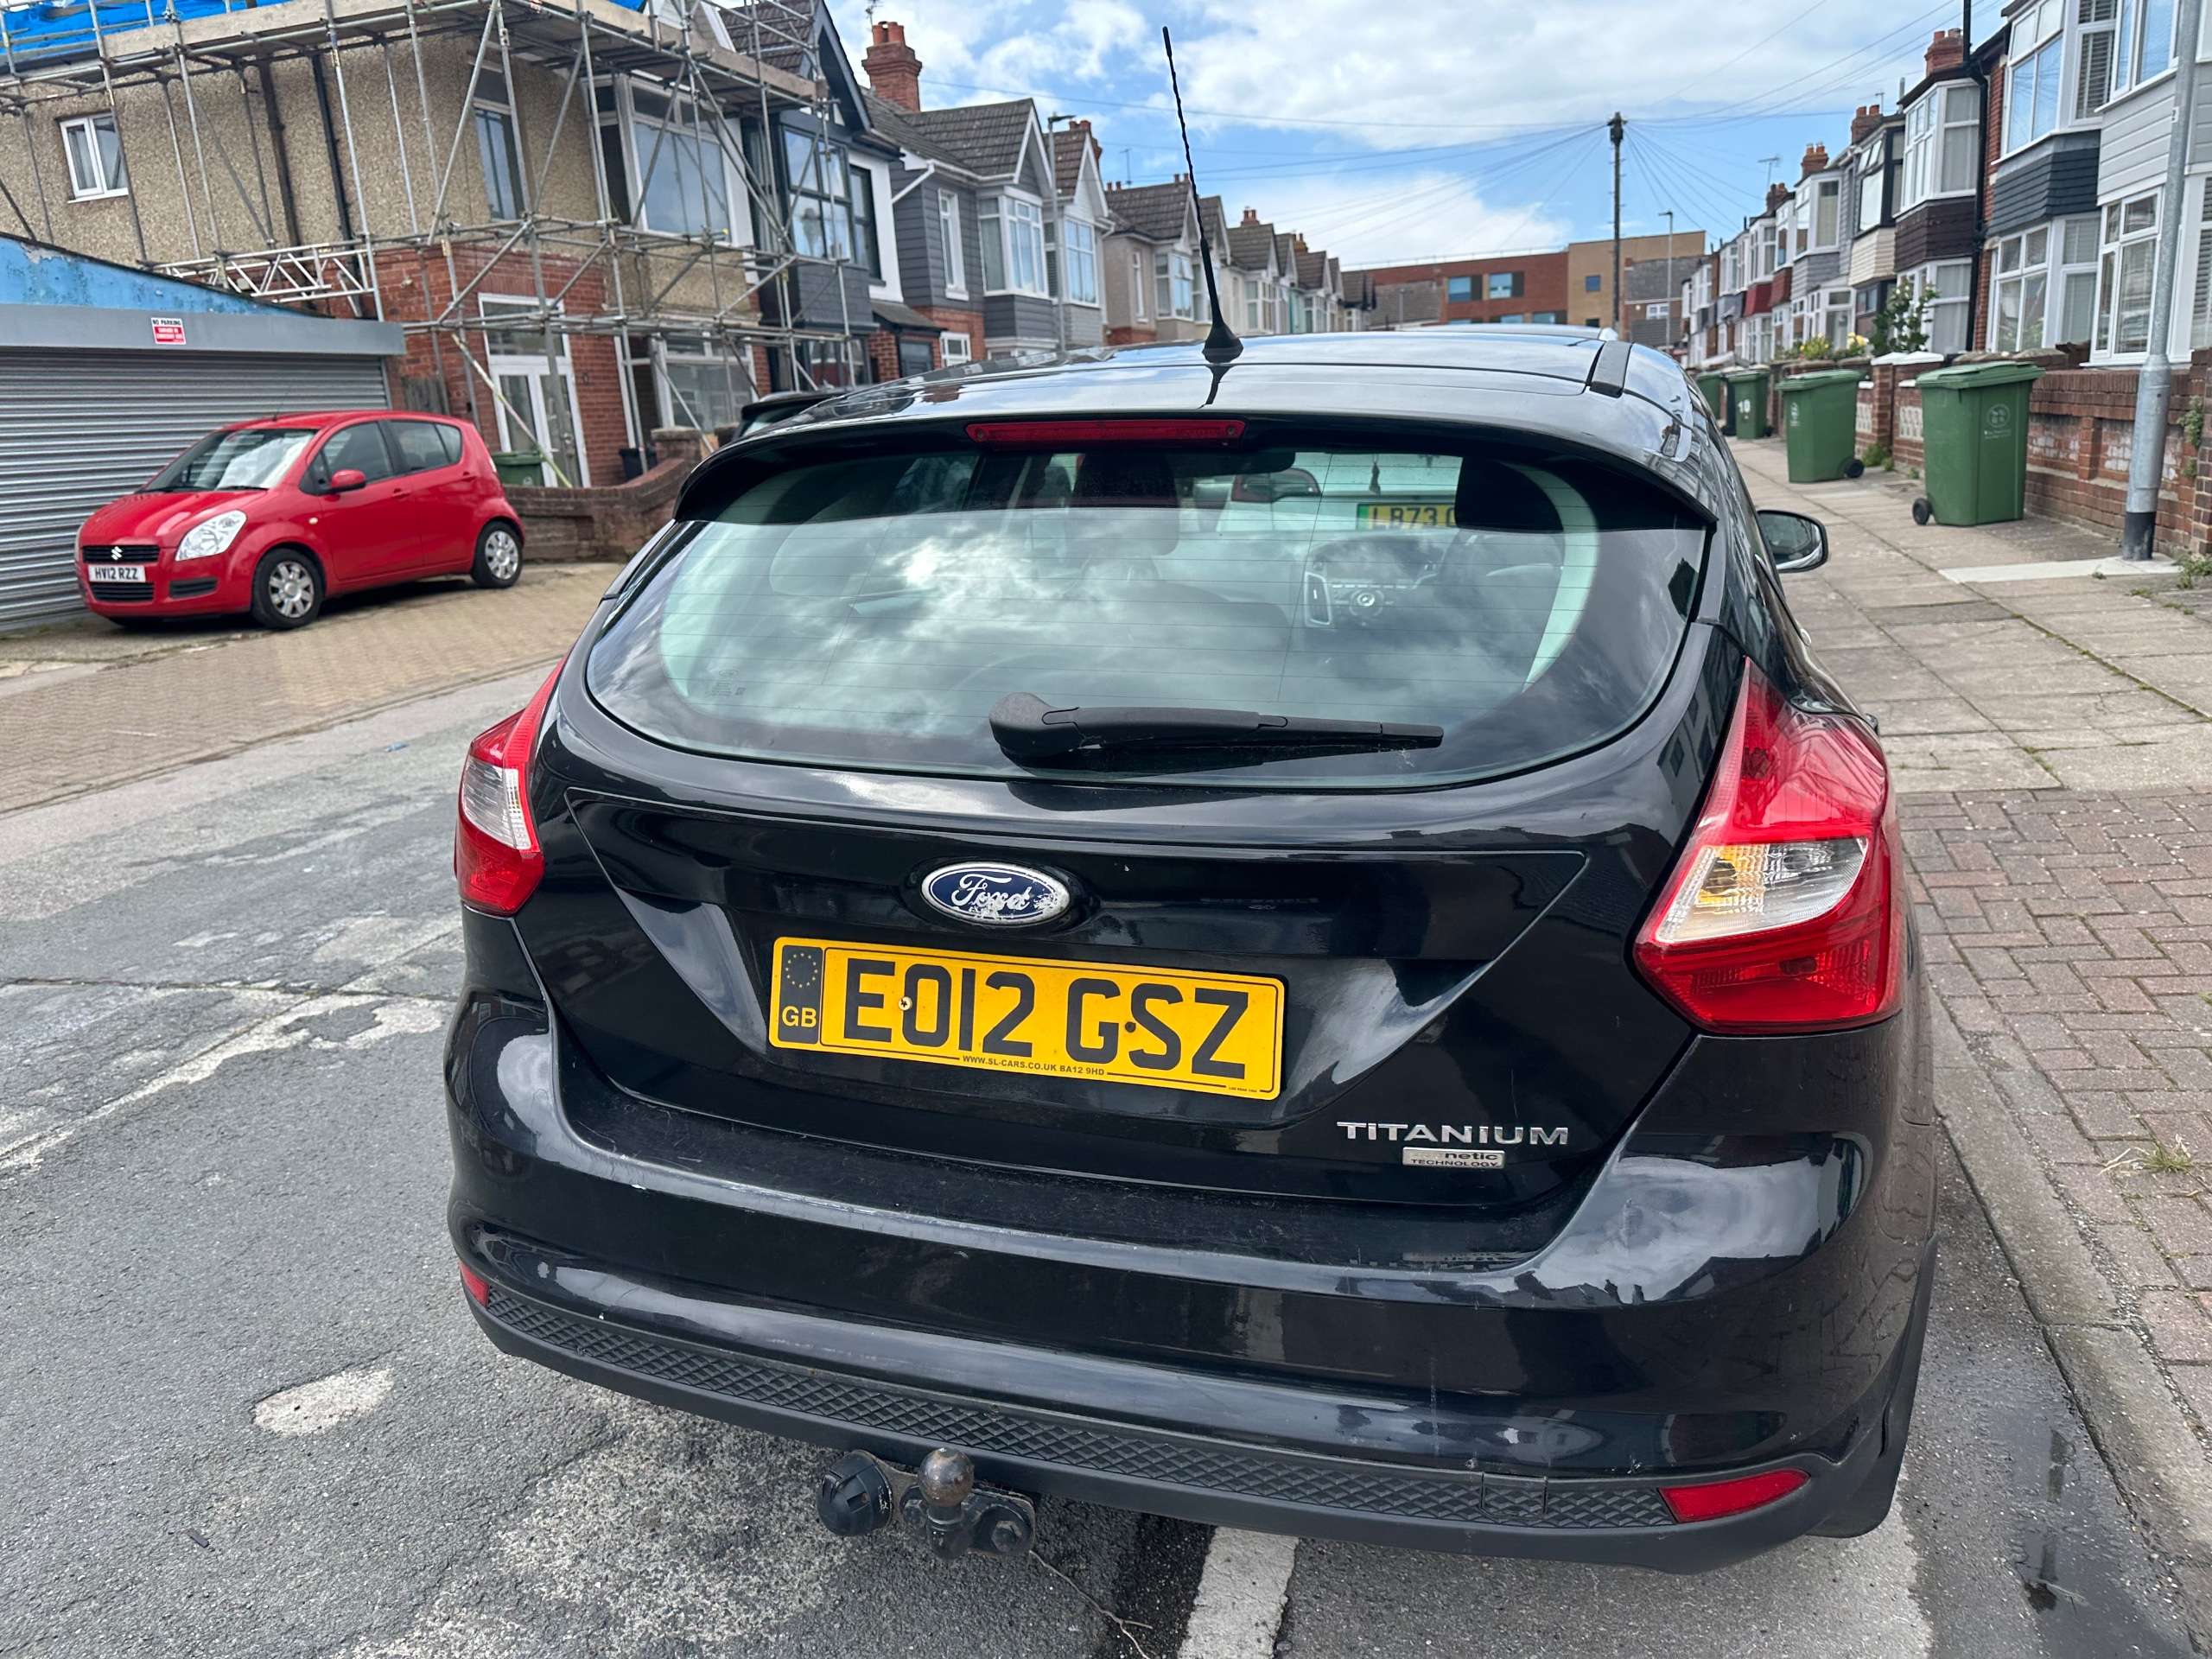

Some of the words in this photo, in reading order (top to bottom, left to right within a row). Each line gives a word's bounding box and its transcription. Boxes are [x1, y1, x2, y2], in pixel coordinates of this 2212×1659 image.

[95, 567, 117, 580] HV12
[118, 567, 138, 580] RZZ
[951, 874, 1033, 911] Ford
[781, 1005, 817, 1028] GB
[844, 957, 1036, 1058] EO12
[1065, 977, 1249, 1080] GSZ
[962, 1055, 1057, 1071] WWW.SL-CARS.CO.UK
[1059, 1065, 1084, 1074] BA12
[1085, 1067, 1105, 1076] 9HD
[1337, 1122, 1569, 1145] TITANIUM
[1410, 1158, 1498, 1167] TECHNOLOGY
